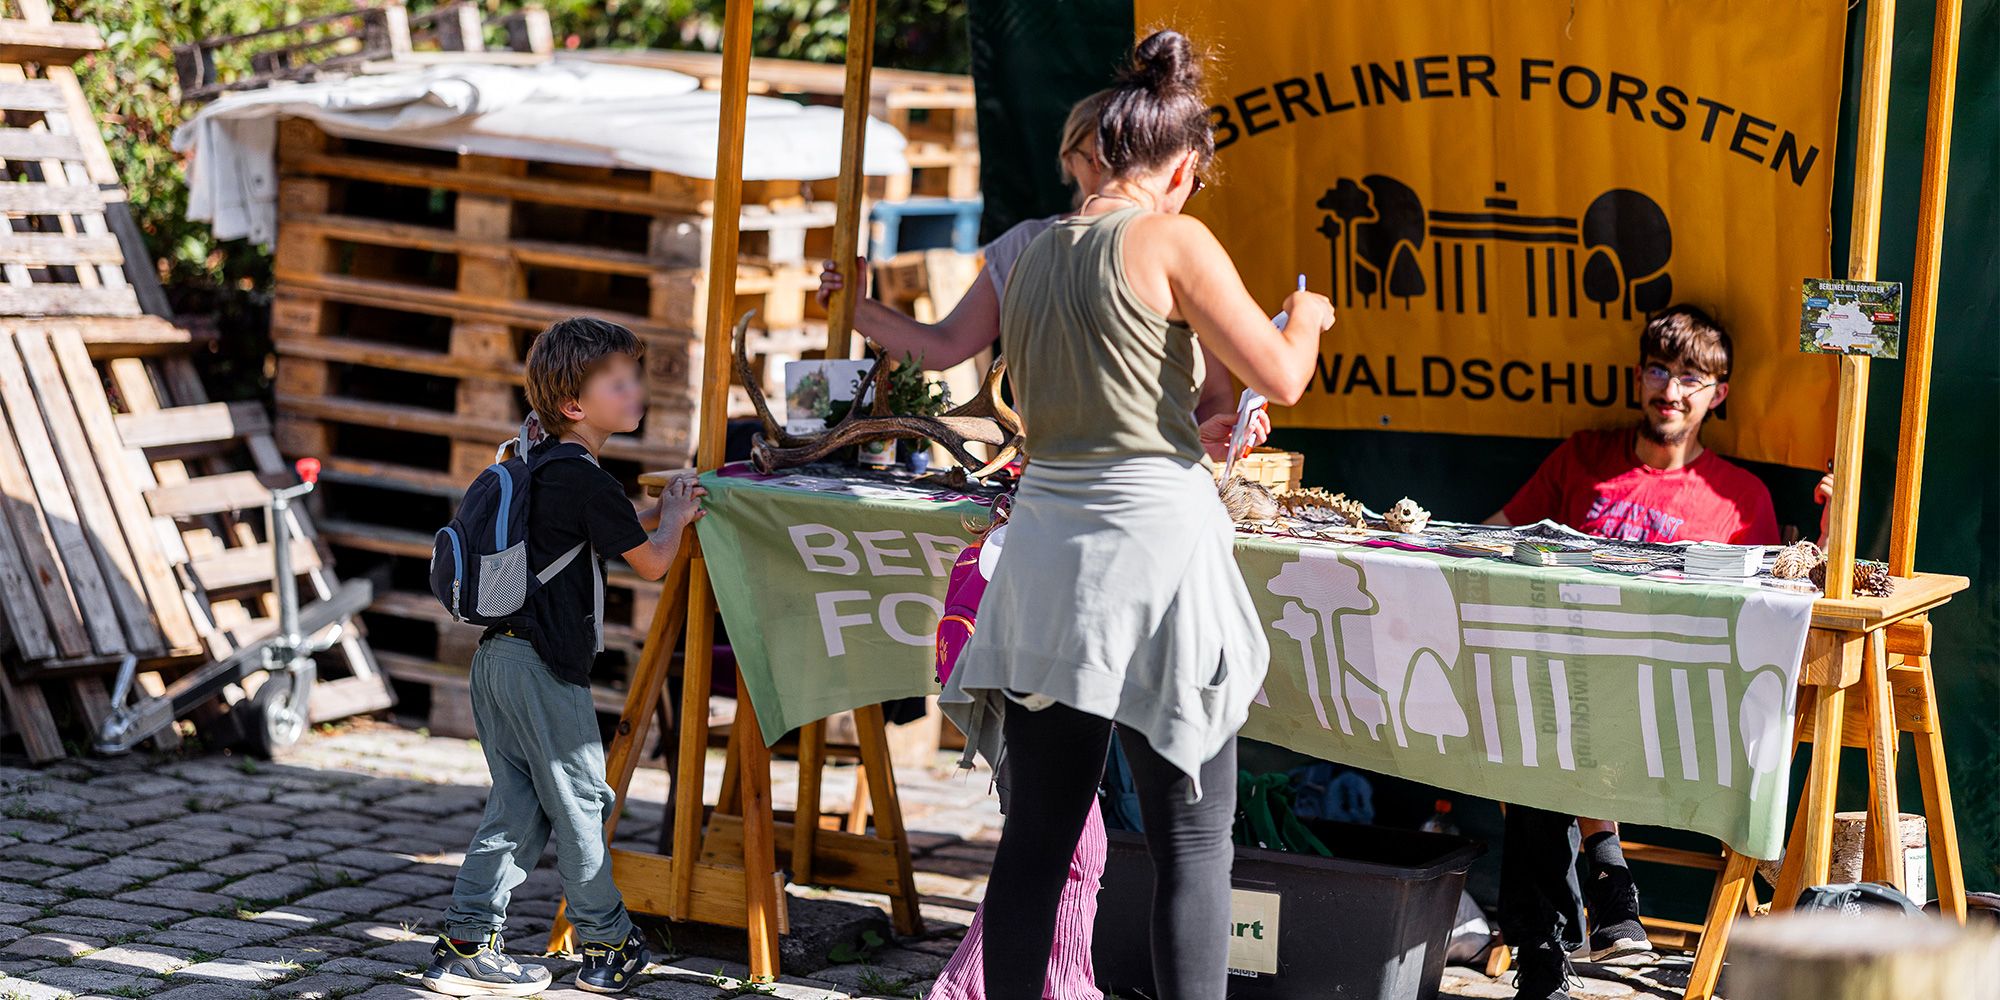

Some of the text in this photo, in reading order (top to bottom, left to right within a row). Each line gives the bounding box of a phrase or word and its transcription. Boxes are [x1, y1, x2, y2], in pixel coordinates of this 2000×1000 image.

[1209, 54, 1820, 187] BERLINER FORSTEN
[1819, 282, 1844, 292] BERLINER
